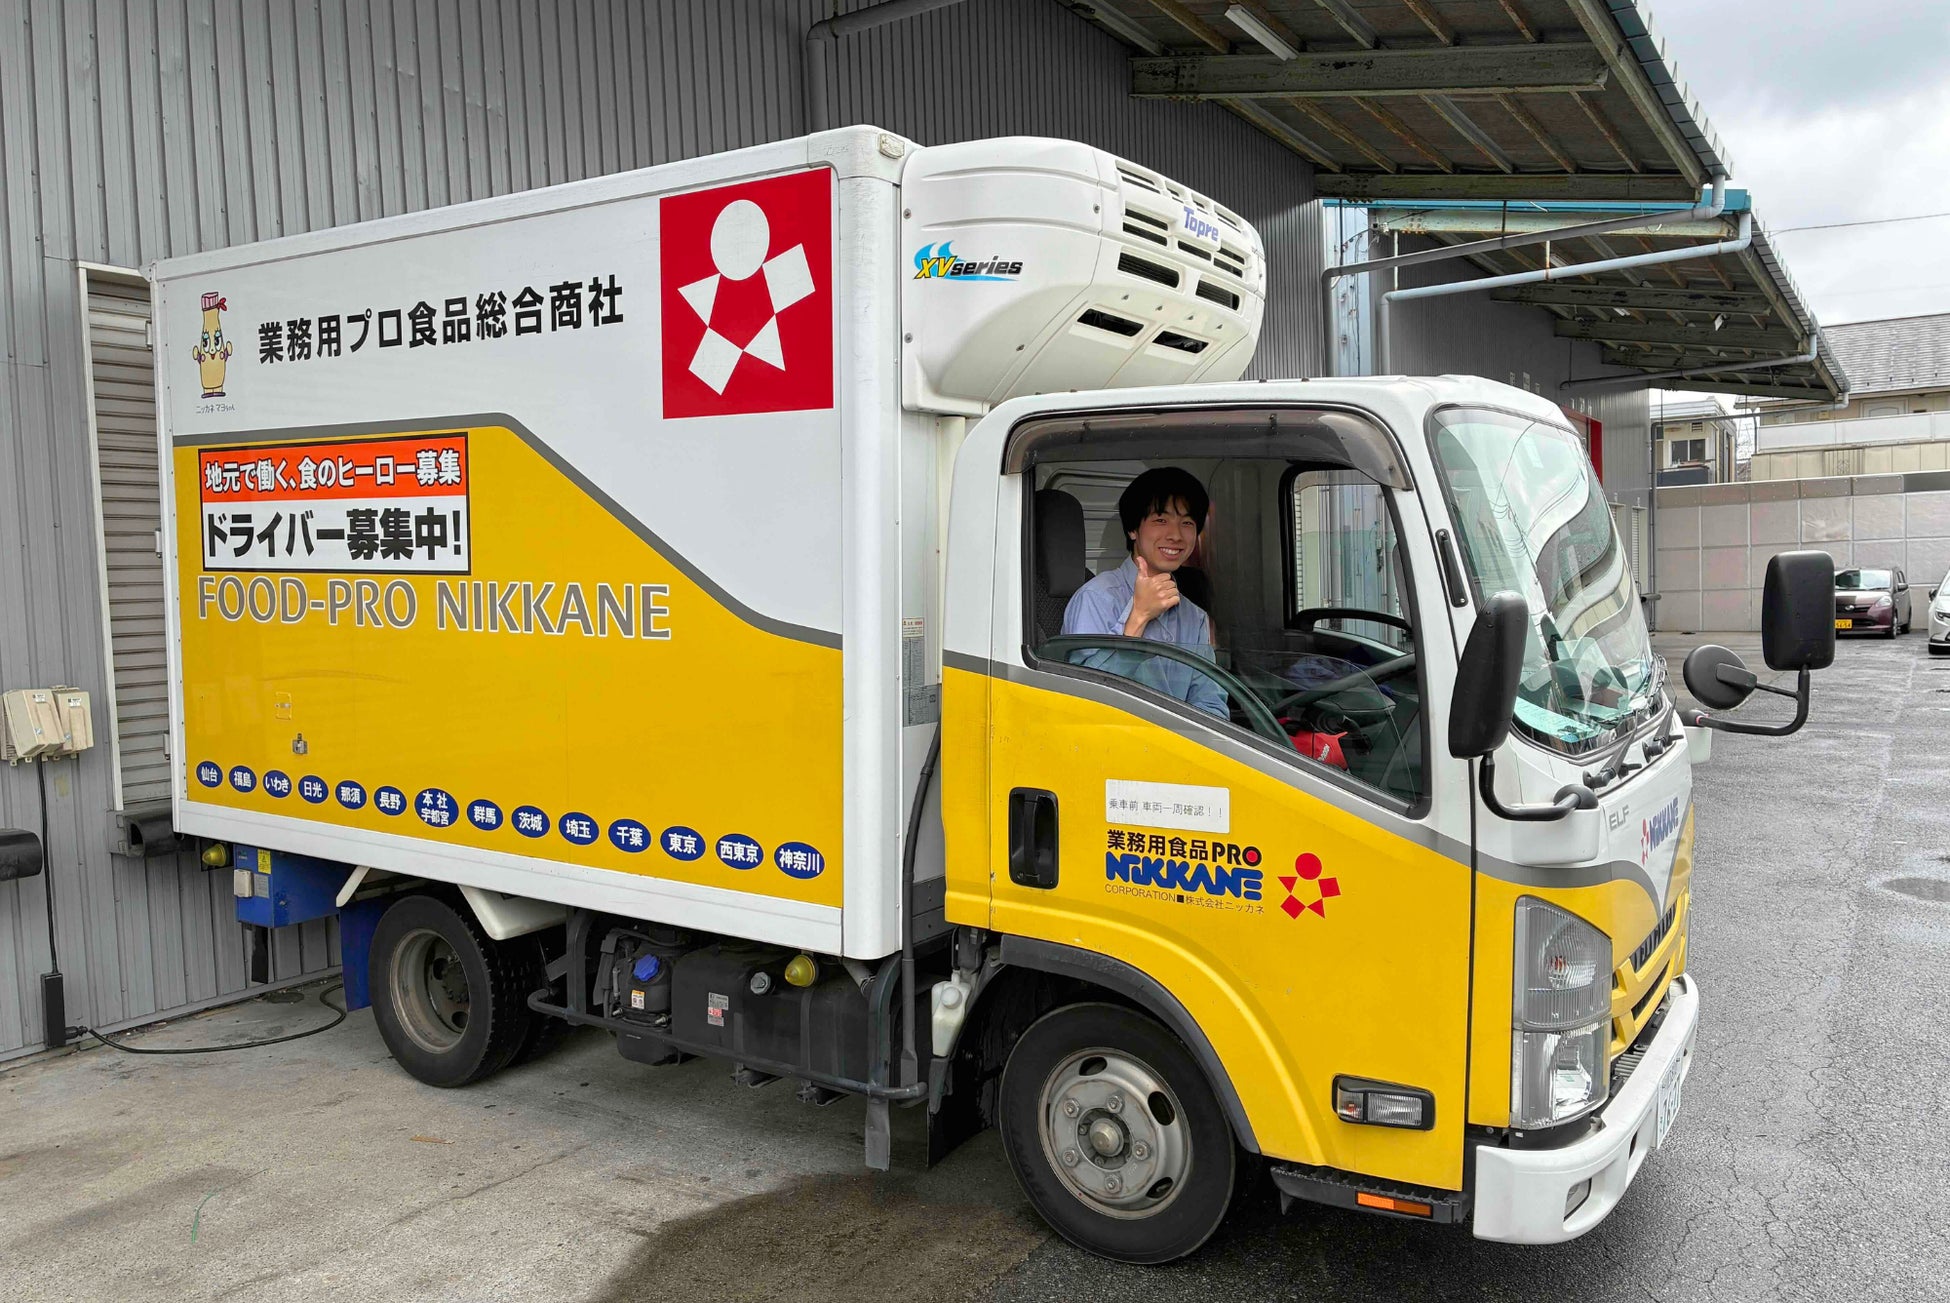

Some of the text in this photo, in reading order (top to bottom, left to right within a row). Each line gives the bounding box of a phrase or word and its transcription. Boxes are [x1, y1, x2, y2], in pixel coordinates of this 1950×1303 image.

[1183, 206, 1219, 242] Topre
[258, 274, 624, 364] 業務用プロ食品総合商社
[205, 449, 461, 493] 地元で働く、食のヒーロー募集
[207, 507, 463, 561] ドライバー募集中!
[198, 575, 671, 640] FOOD-PRO NIKKANE
[201, 766, 218, 783] 仙台
[233, 771, 252, 788] 福島
[264, 776, 290, 793] いわき
[304, 781, 323, 798] 日光
[340, 786, 361, 804] 那須
[379, 792, 401, 811] 長野
[1108, 798, 1139, 813] 乗車前
[421, 807, 450, 826] 宇都宮
[474, 805, 496, 825] 群馬
[518, 812, 543, 832] 茨城
[1608, 804, 1630, 831] ELF
[1649, 796, 1679, 851] NIKKANE
[566, 819, 592, 839] 埼玉
[616, 826, 643, 847] 千葉
[668, 832, 698, 855] 東京
[719, 840, 760, 864] 西東京
[1106, 829, 1262, 867] 業務用食品PRO
[779, 848, 821, 874] 神奈川
[1105, 851, 1264, 901] NIKKANE
[1104, 883, 1265, 915] CORPORATION 株式会社ニッカネ
